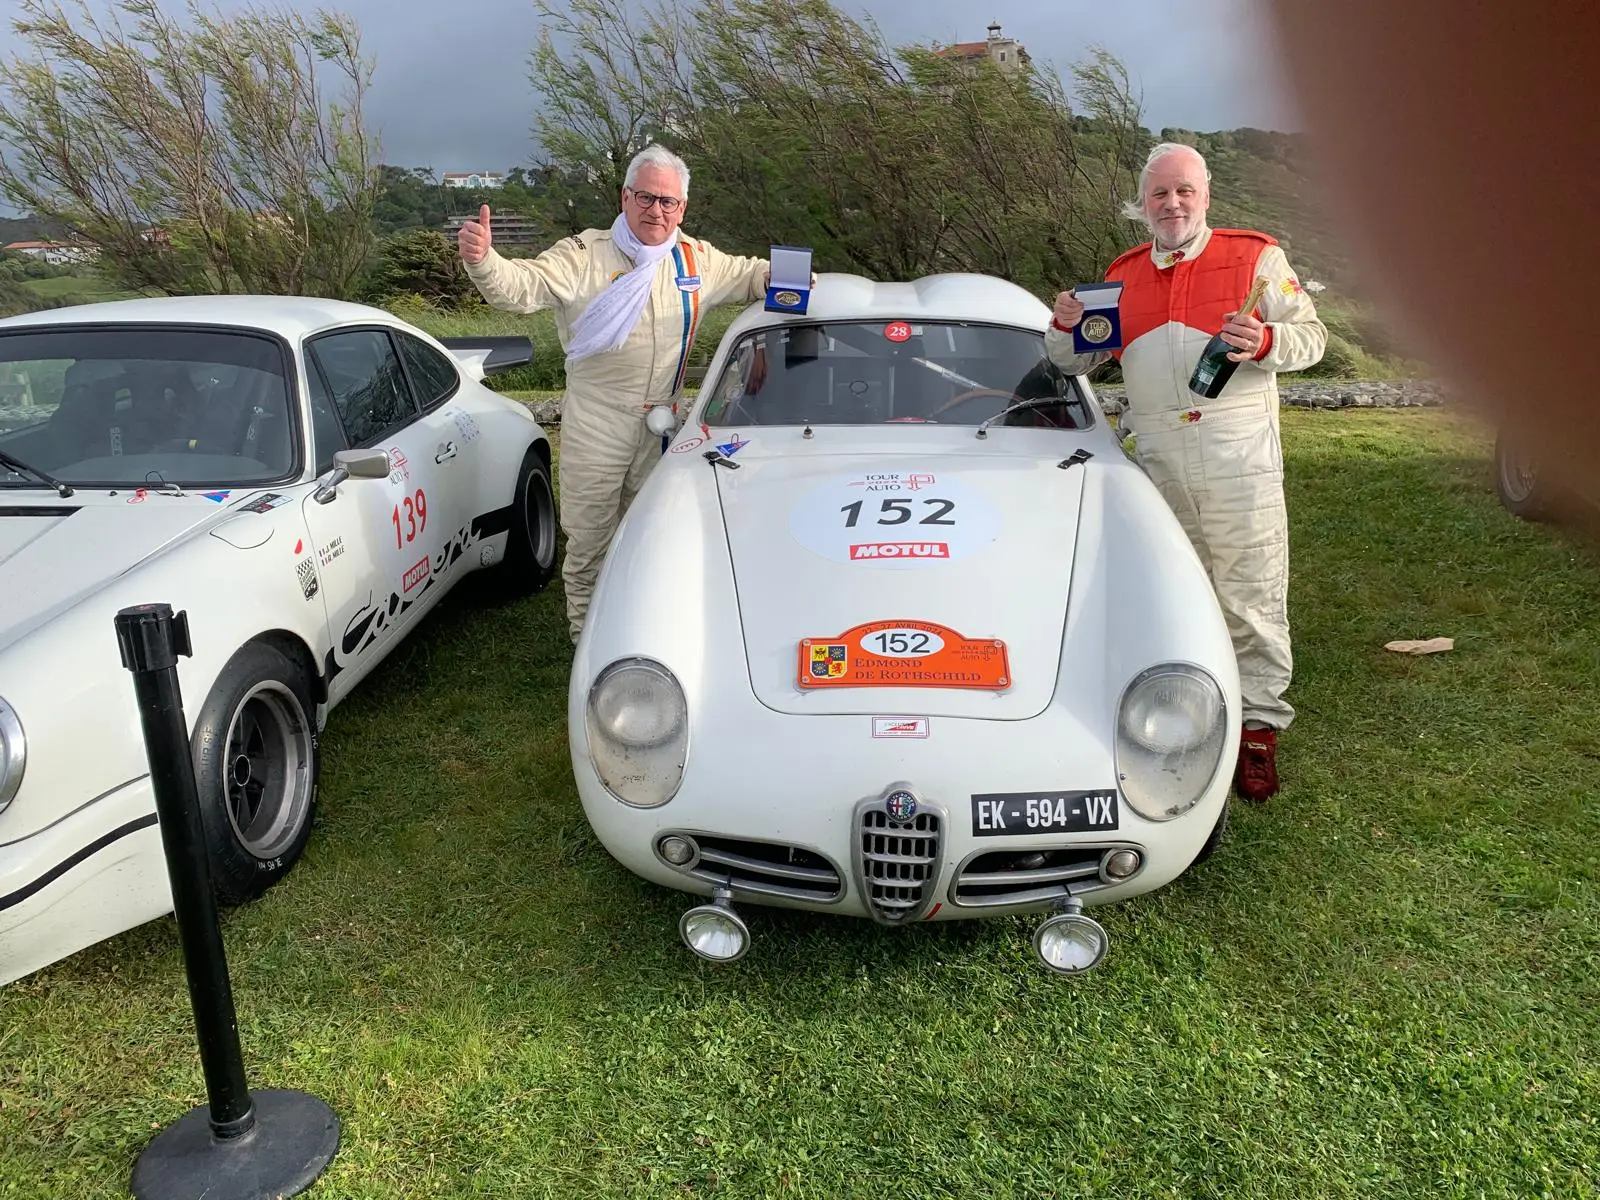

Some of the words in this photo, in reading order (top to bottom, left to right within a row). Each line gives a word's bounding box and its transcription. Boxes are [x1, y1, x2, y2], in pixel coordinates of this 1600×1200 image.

[890, 326, 907, 337] 28
[865, 484, 901, 492] AUTO
[392, 488, 428, 550] 139
[840, 498, 956, 528] 152
[854, 543, 945, 558] MOTUL
[404, 558, 429, 590] MOTUL
[875, 633, 930, 653] 152
